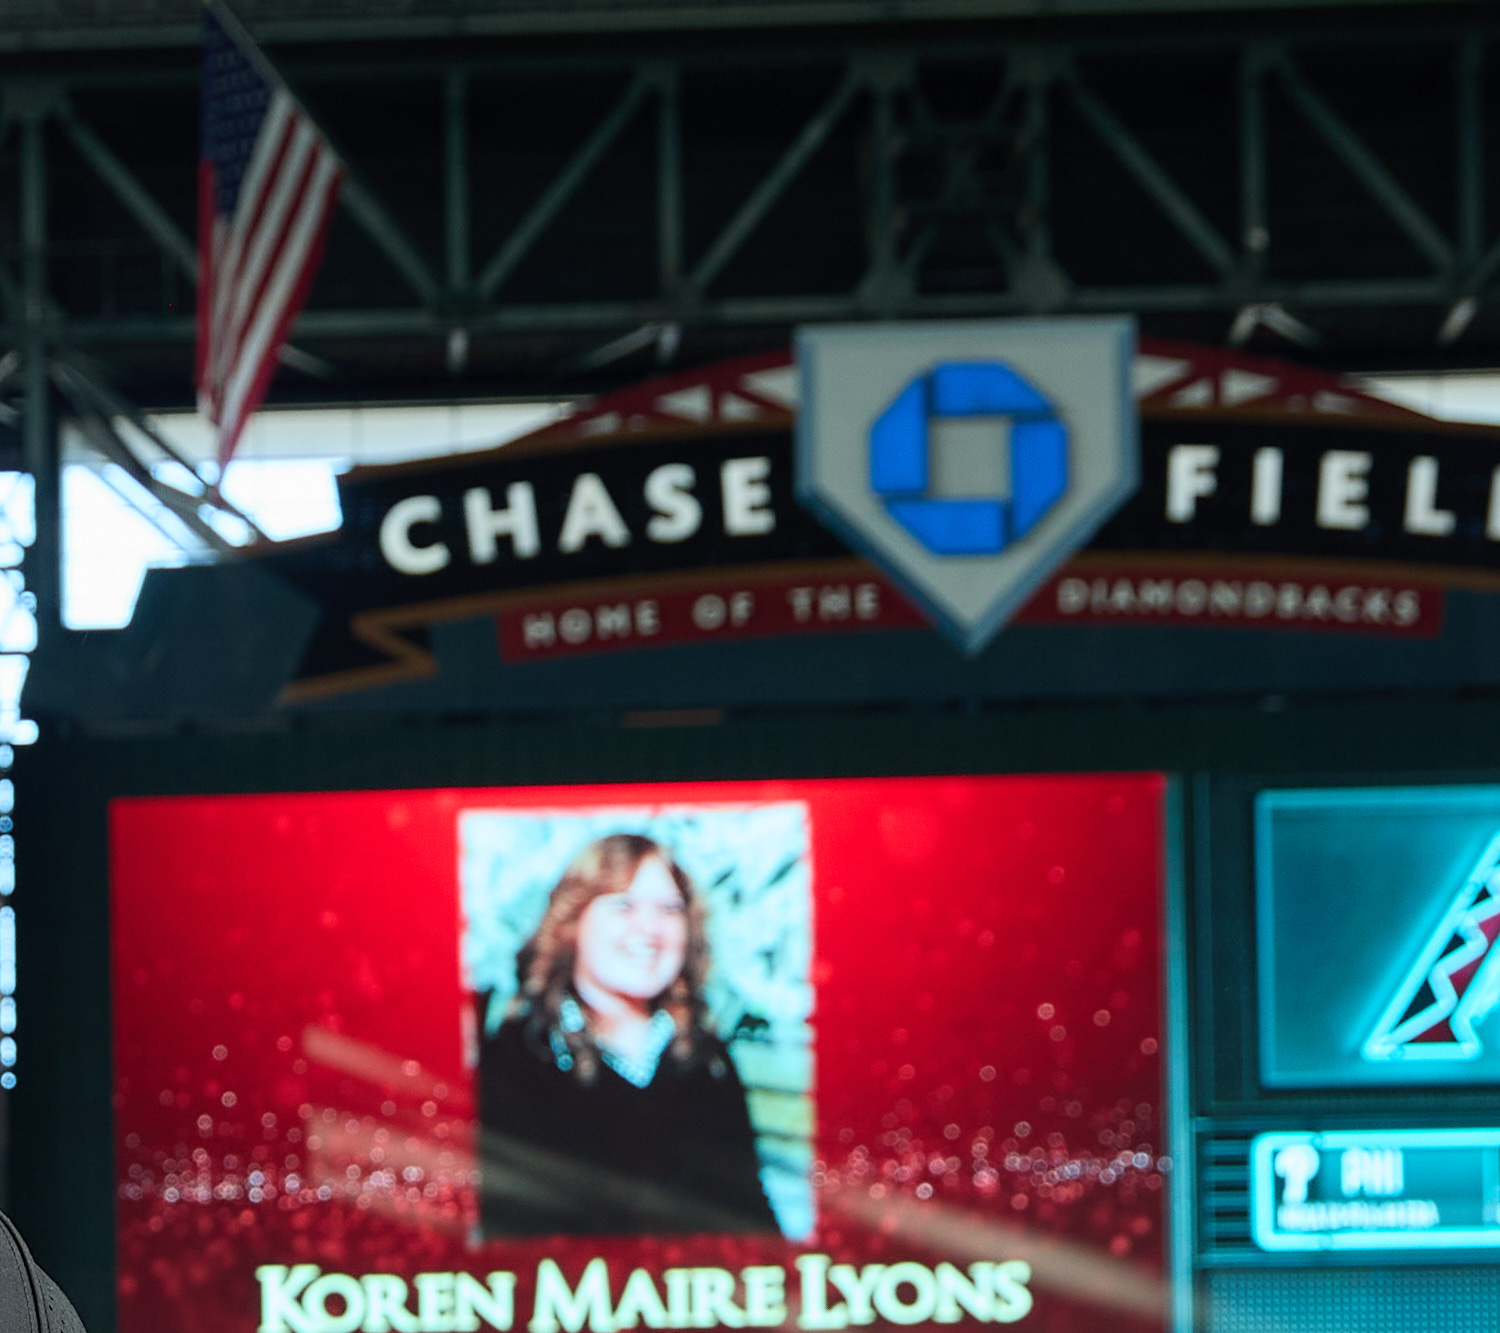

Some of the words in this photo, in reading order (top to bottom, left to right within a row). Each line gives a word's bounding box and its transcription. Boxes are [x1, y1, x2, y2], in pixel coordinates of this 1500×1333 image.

[378, 456, 777, 576] CHASE
[522, 600, 662, 649] HOME
[692, 595, 754, 630] OF
[786, 584, 882, 624] THE
[1055, 578, 1423, 627] DIAMONDBACKS
[795, 1254, 1033, 1331] LYONS
